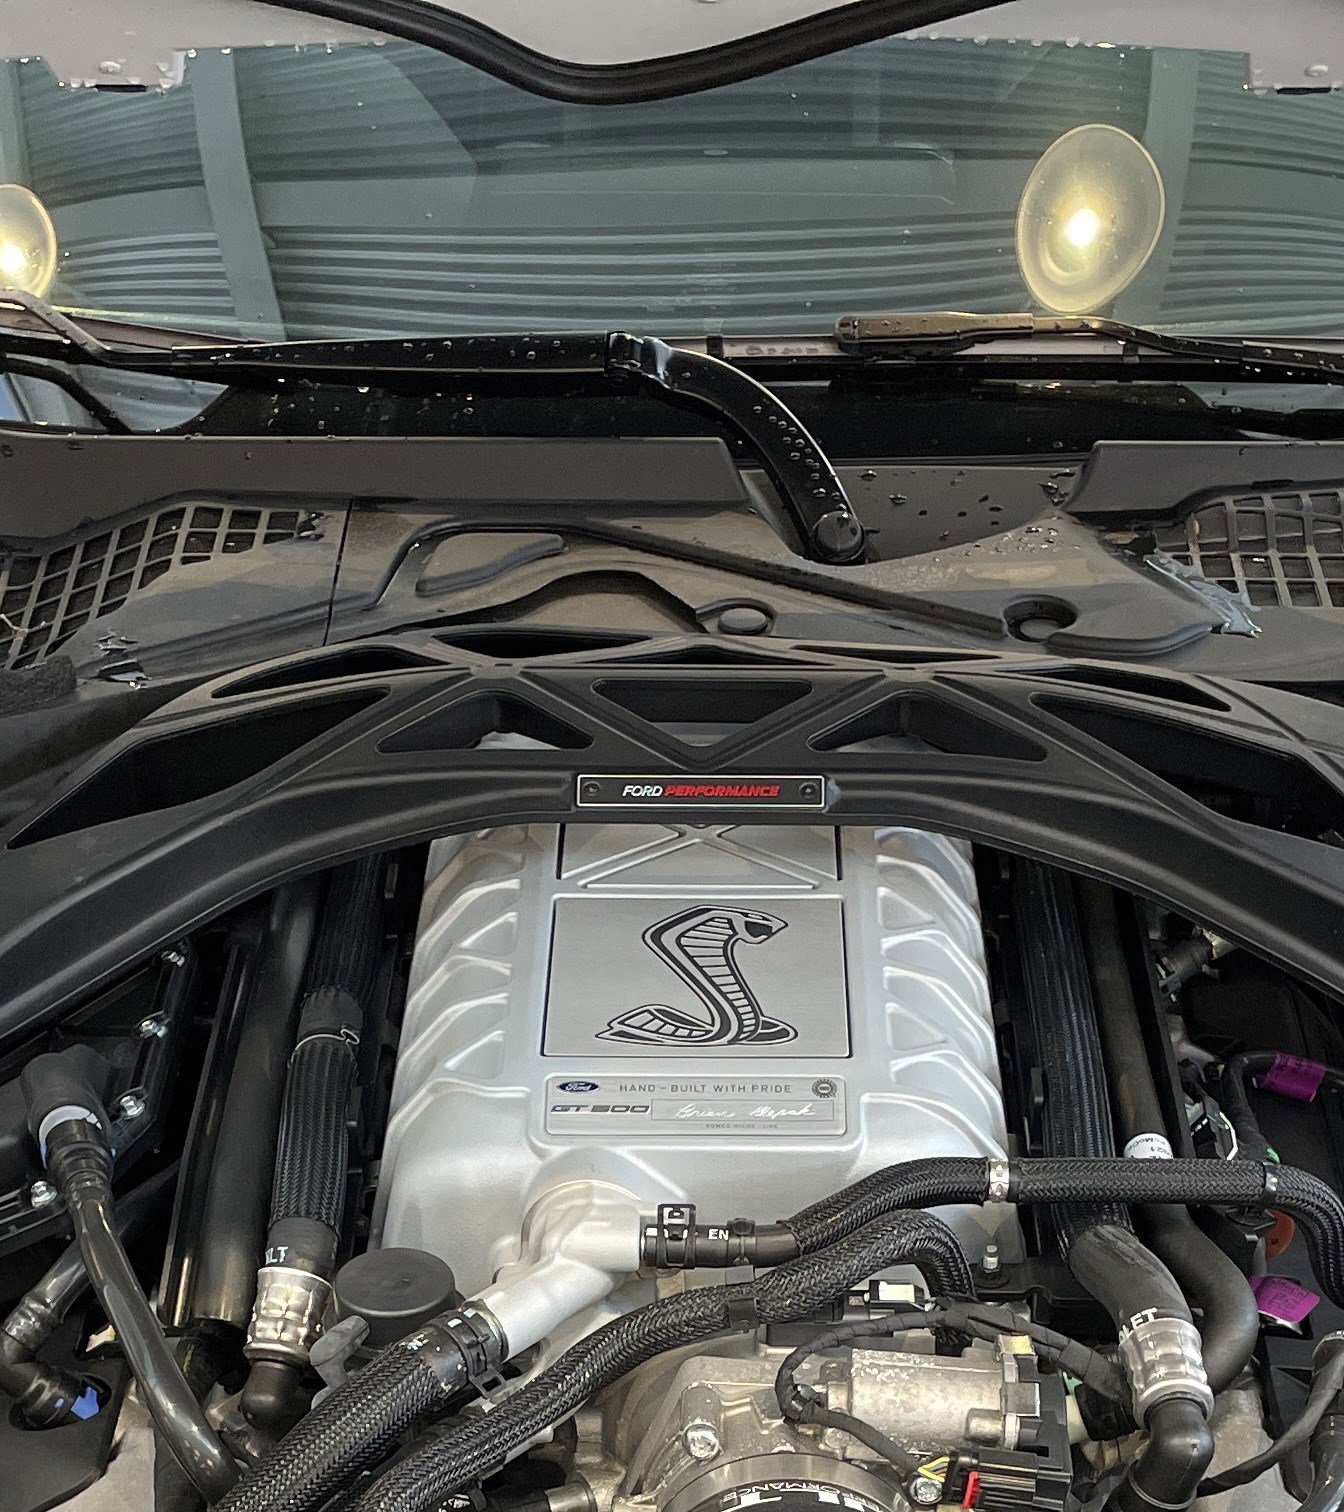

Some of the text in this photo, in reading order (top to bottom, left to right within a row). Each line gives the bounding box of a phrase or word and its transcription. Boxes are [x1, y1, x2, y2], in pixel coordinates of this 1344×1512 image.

[622, 785, 780, 797] FORD PERFORMANCE
[561, 1081, 597, 1094] Ford
[619, 1083, 656, 1094] HAND
[670, 1083, 706, 1094] BUILT
[712, 1083, 747, 1094] WITH
[751, 1083, 792, 1094] PRIDE
[708, 1228, 729, 1241] EN
